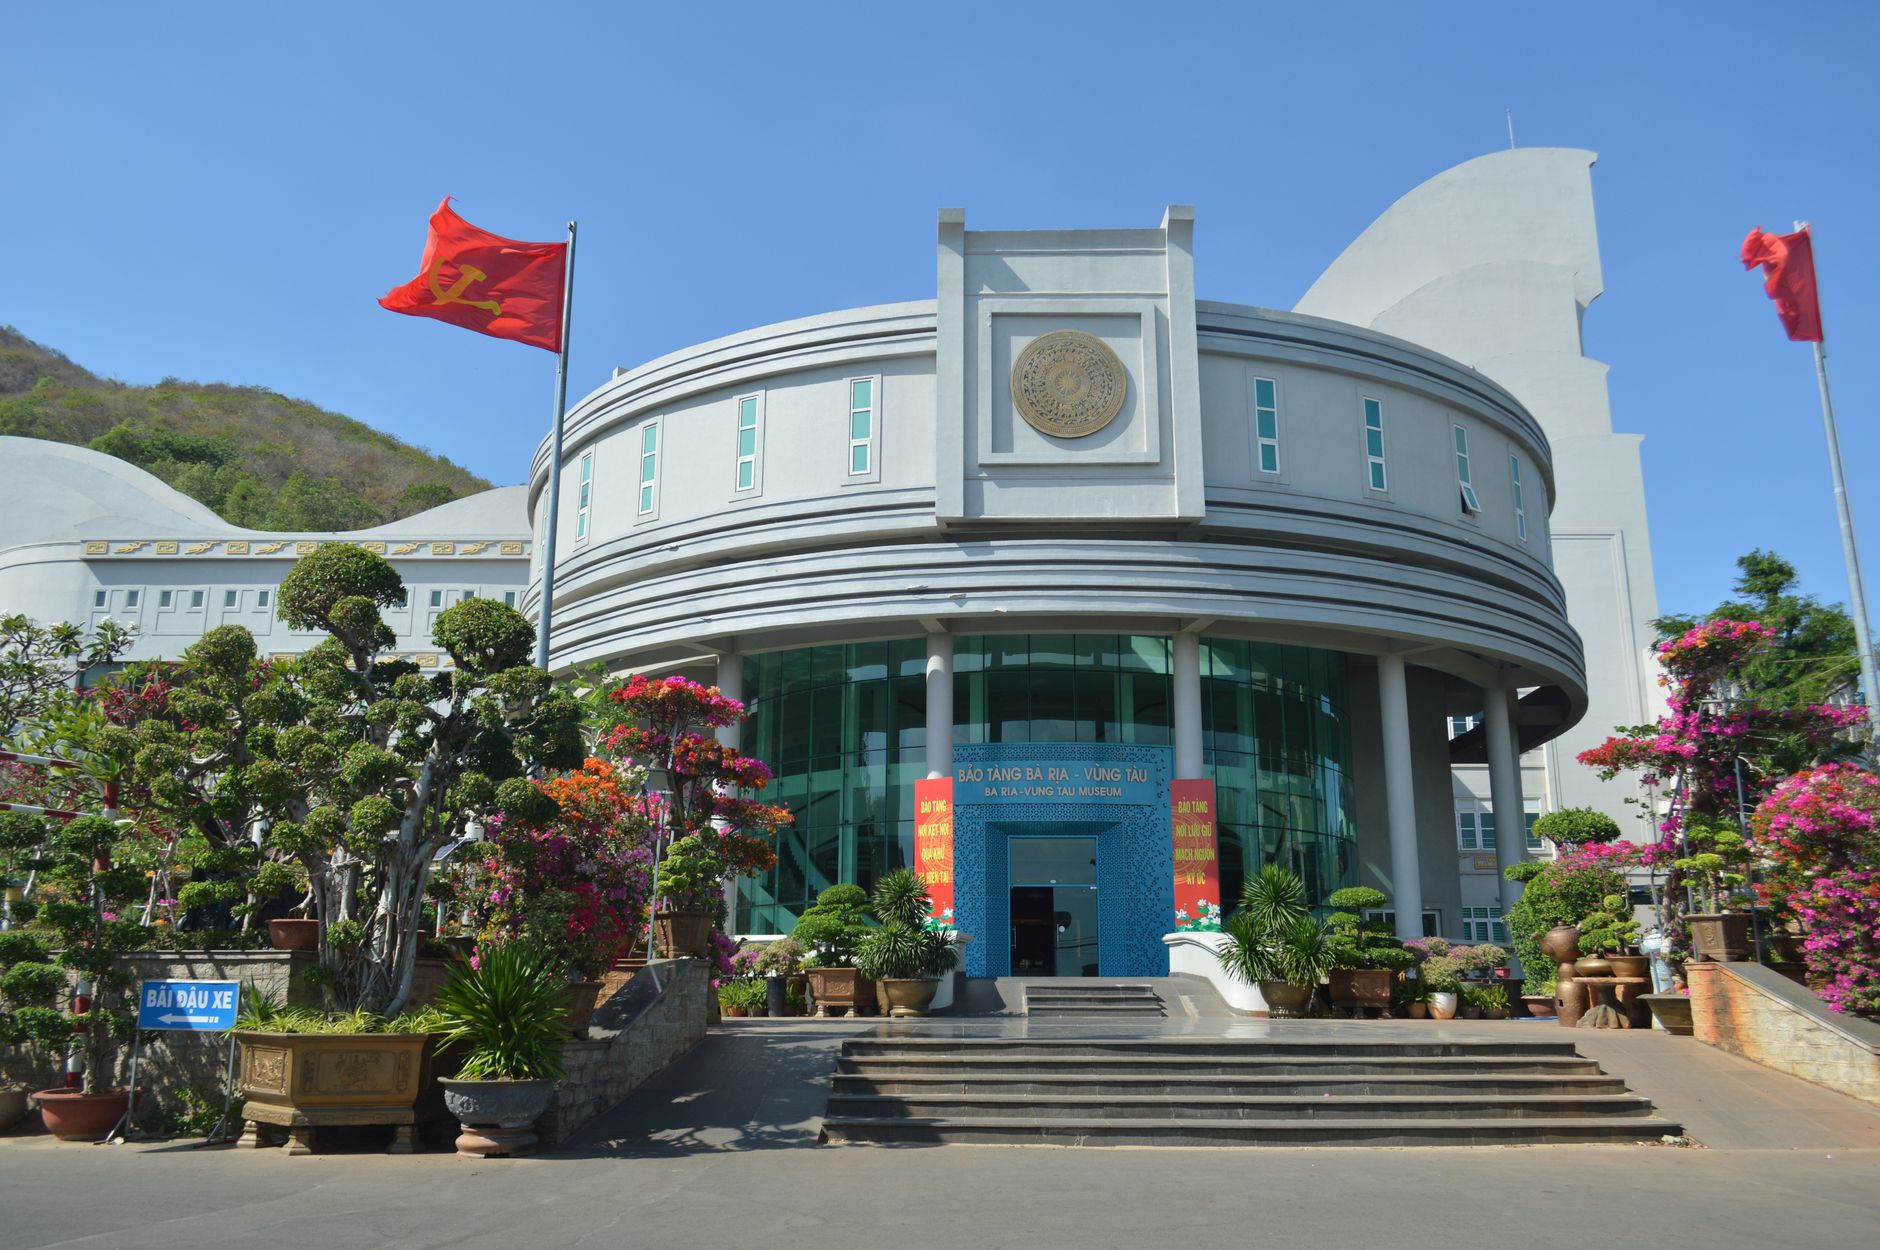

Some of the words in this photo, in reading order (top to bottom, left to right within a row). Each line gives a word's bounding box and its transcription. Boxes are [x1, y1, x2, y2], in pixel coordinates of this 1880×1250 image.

[958, 763, 984, 782] BẢO
[986, 764, 1022, 781] TÀNG
[1026, 764, 1043, 781] BÀ
[1048, 768, 1069, 784] RỊA
[1126, 764, 1148, 782] TÀU
[985, 787, 998, 796] BA
[1057, 787, 1076, 796] TAU
[1079, 787, 1122, 796] MUSEUM
[146, 985, 173, 1008] BÃI
[176, 986, 208, 1014] ĐẬU
[212, 990, 233, 1009] XE
